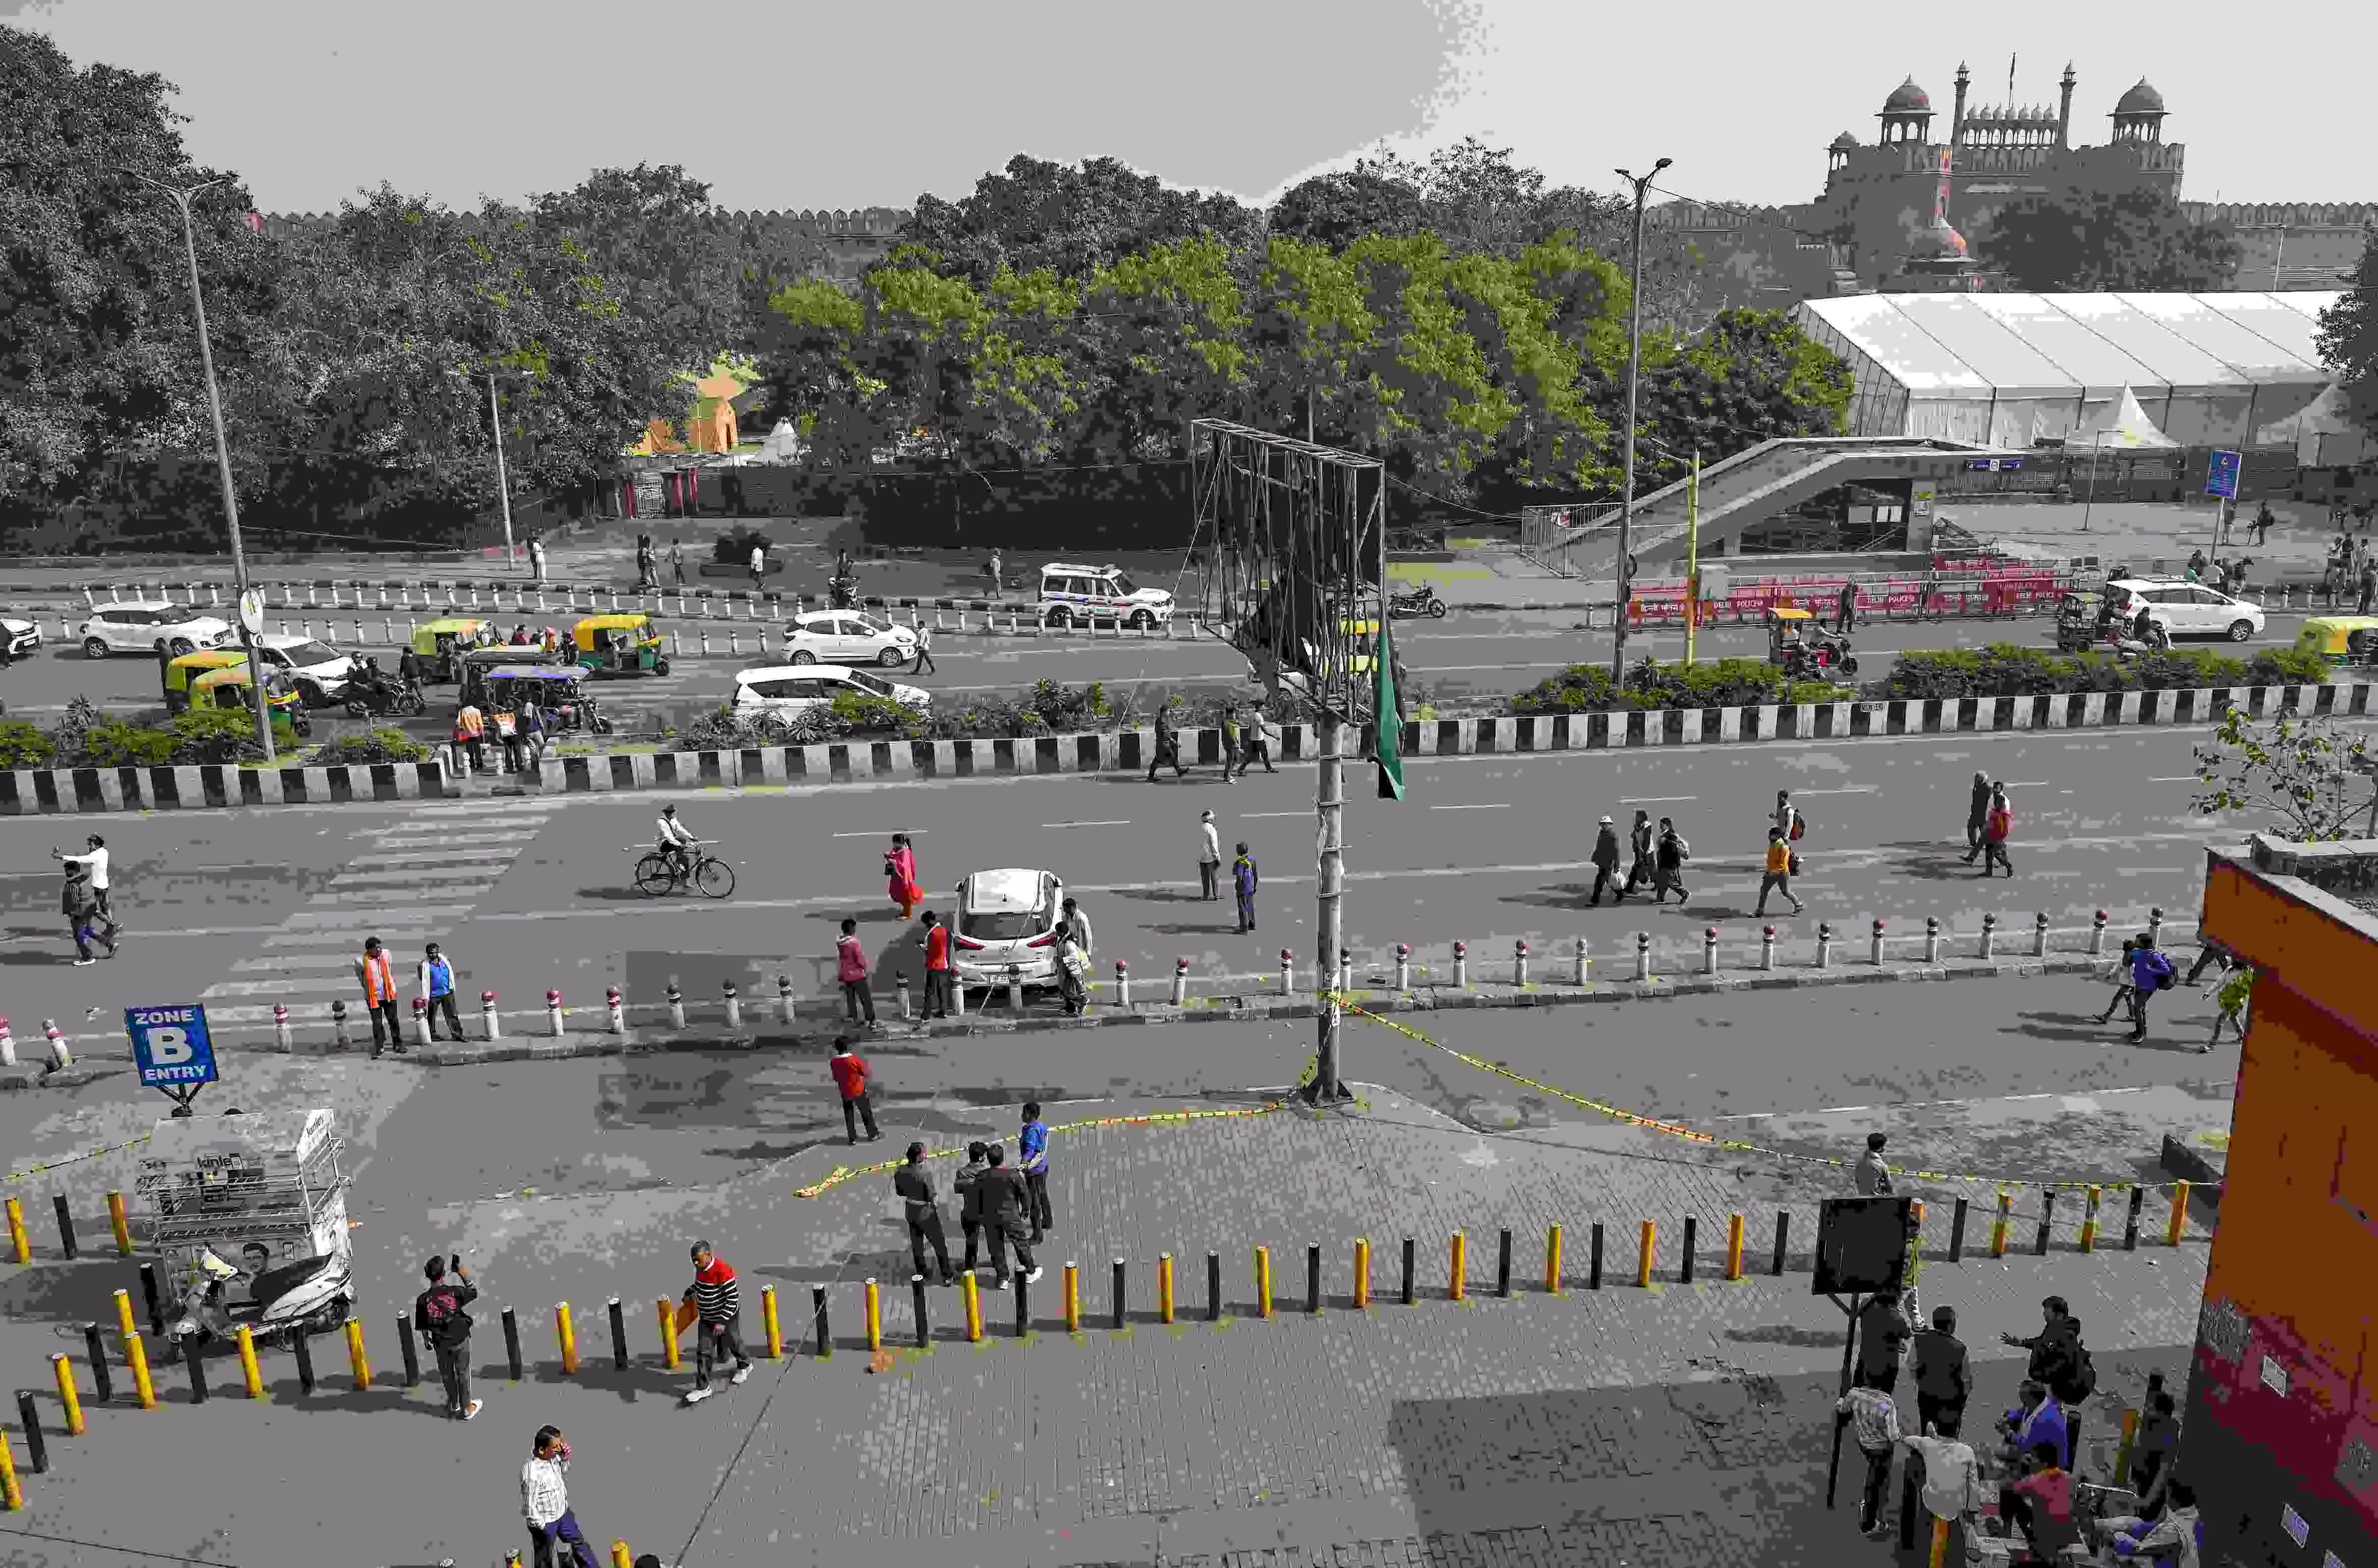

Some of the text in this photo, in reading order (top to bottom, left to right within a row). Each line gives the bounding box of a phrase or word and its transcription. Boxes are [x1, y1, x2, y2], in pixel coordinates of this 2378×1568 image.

[134, 1009, 195, 1026] ZONE
[147, 1027, 192, 1064] B
[145, 1065, 207, 1081] ENTRY
[197, 1155, 236, 1169] kinle
